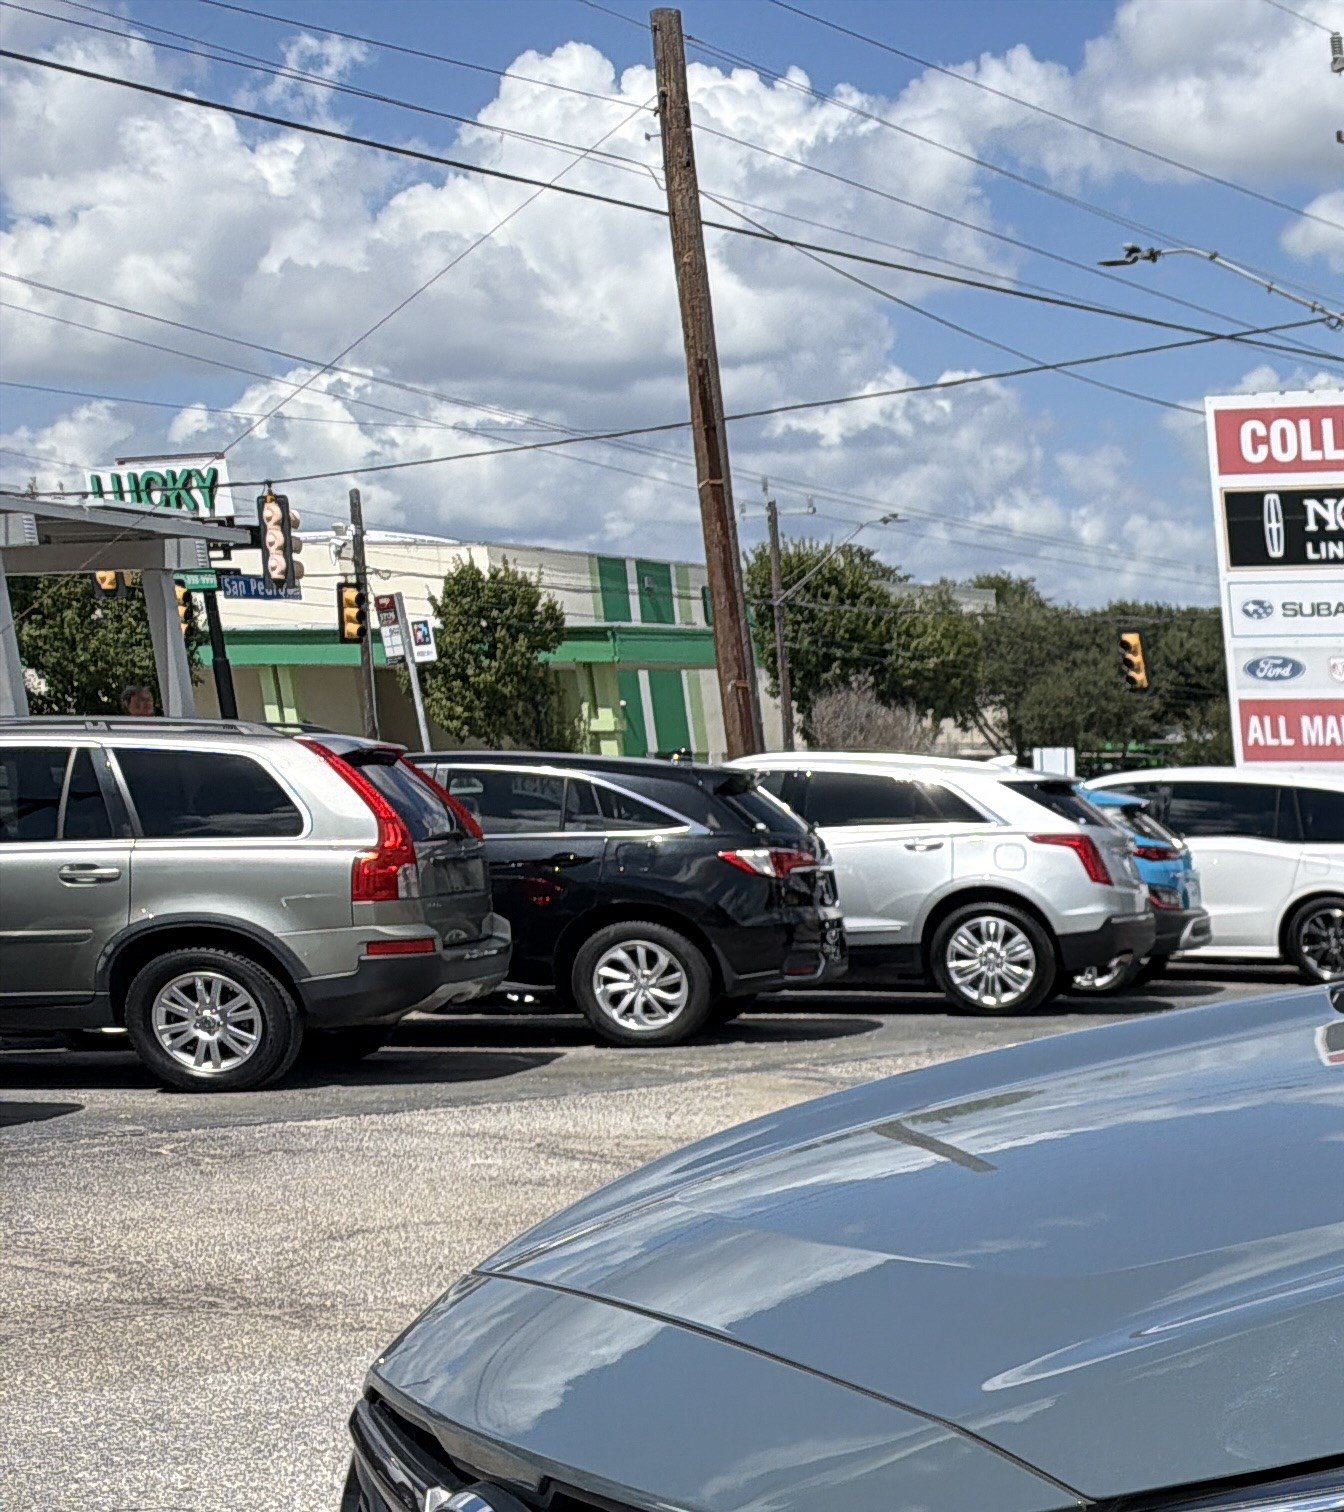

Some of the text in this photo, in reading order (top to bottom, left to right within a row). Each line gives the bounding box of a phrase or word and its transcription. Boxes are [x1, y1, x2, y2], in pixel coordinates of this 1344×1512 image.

[224, 577, 247, 597] San
[1256, 658, 1294, 679] Ford
[1247, 715, 1296, 747] ALL
